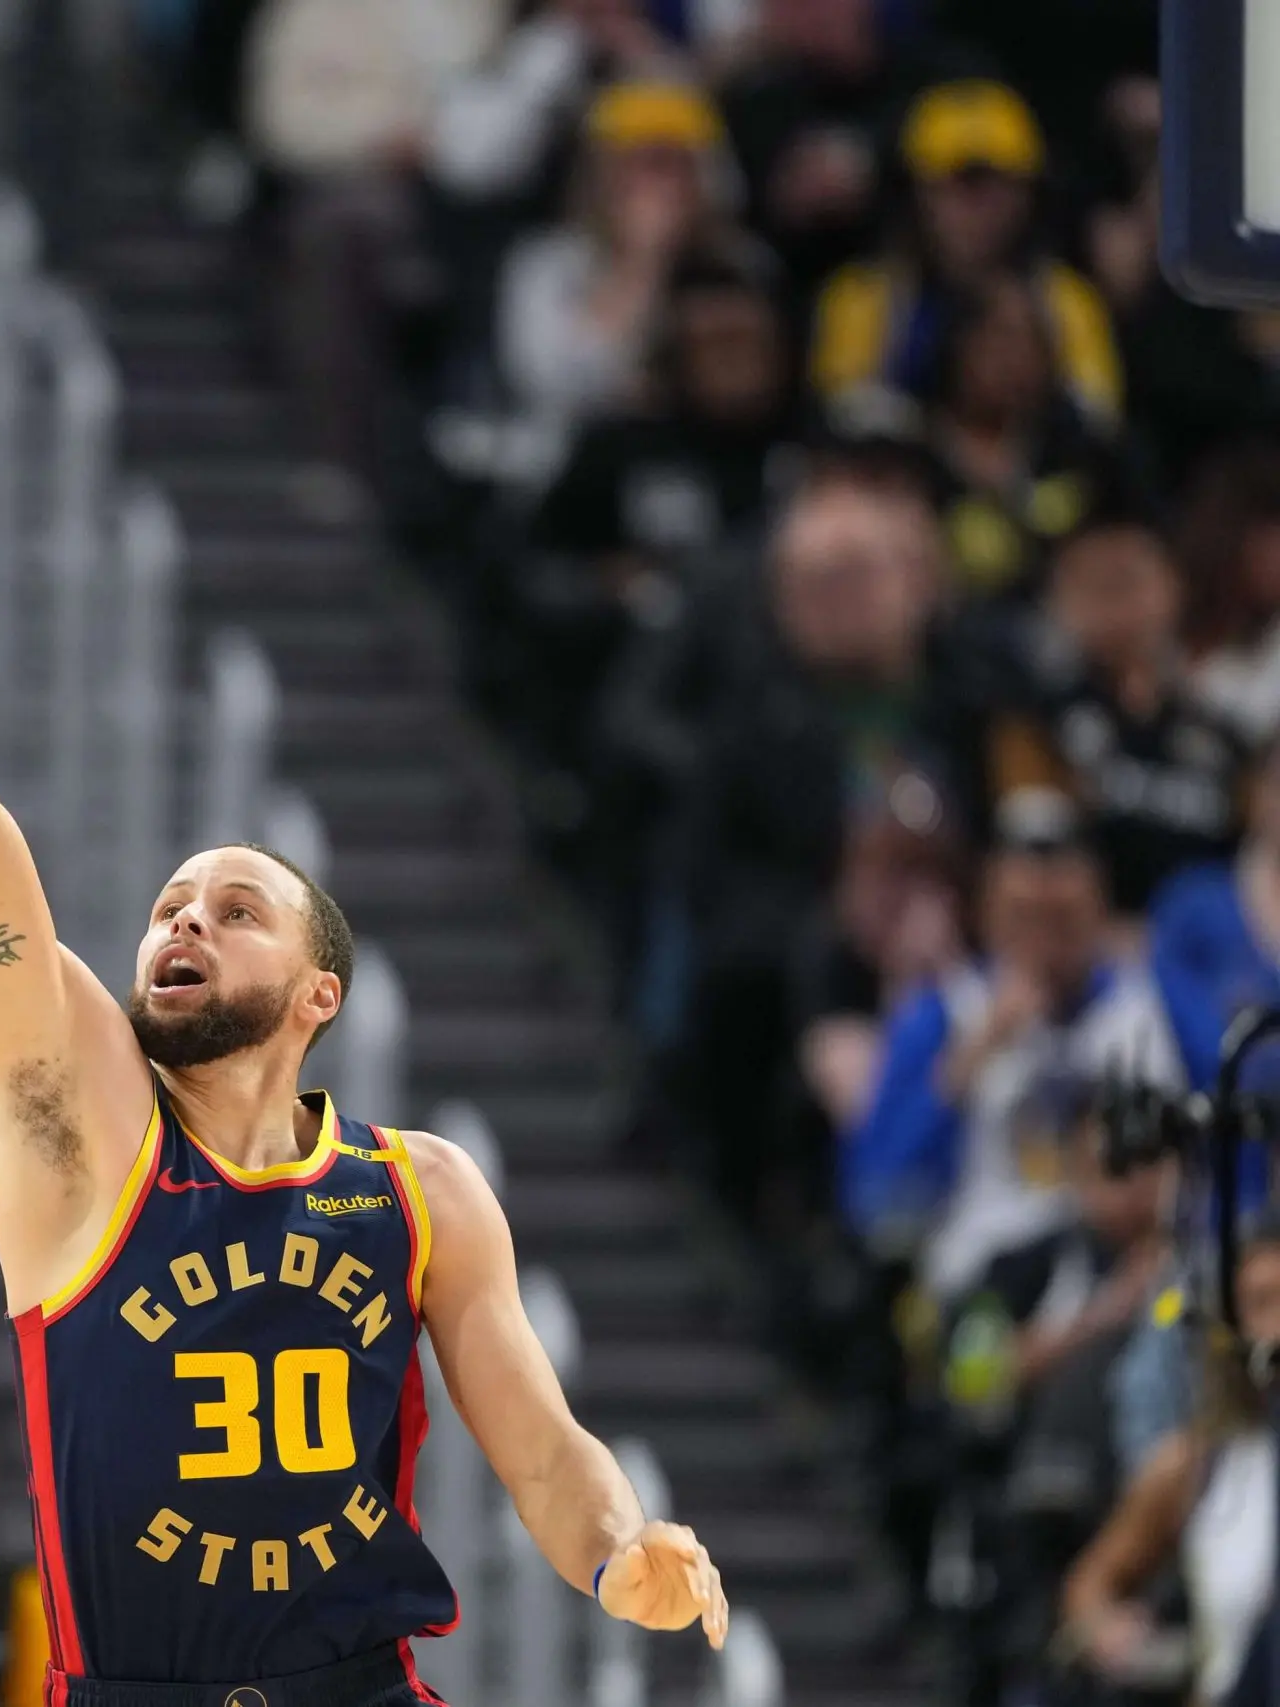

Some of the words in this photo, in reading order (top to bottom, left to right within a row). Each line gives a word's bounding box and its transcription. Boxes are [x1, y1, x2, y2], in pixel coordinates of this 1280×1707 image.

[306, 1193, 393, 1214] Rakuten
[353, 1148, 372, 1160] 16
[120, 1232, 392, 1349] GOLDEN
[174, 1348, 356, 1480] 30
[136, 1484, 388, 1592] STATE
